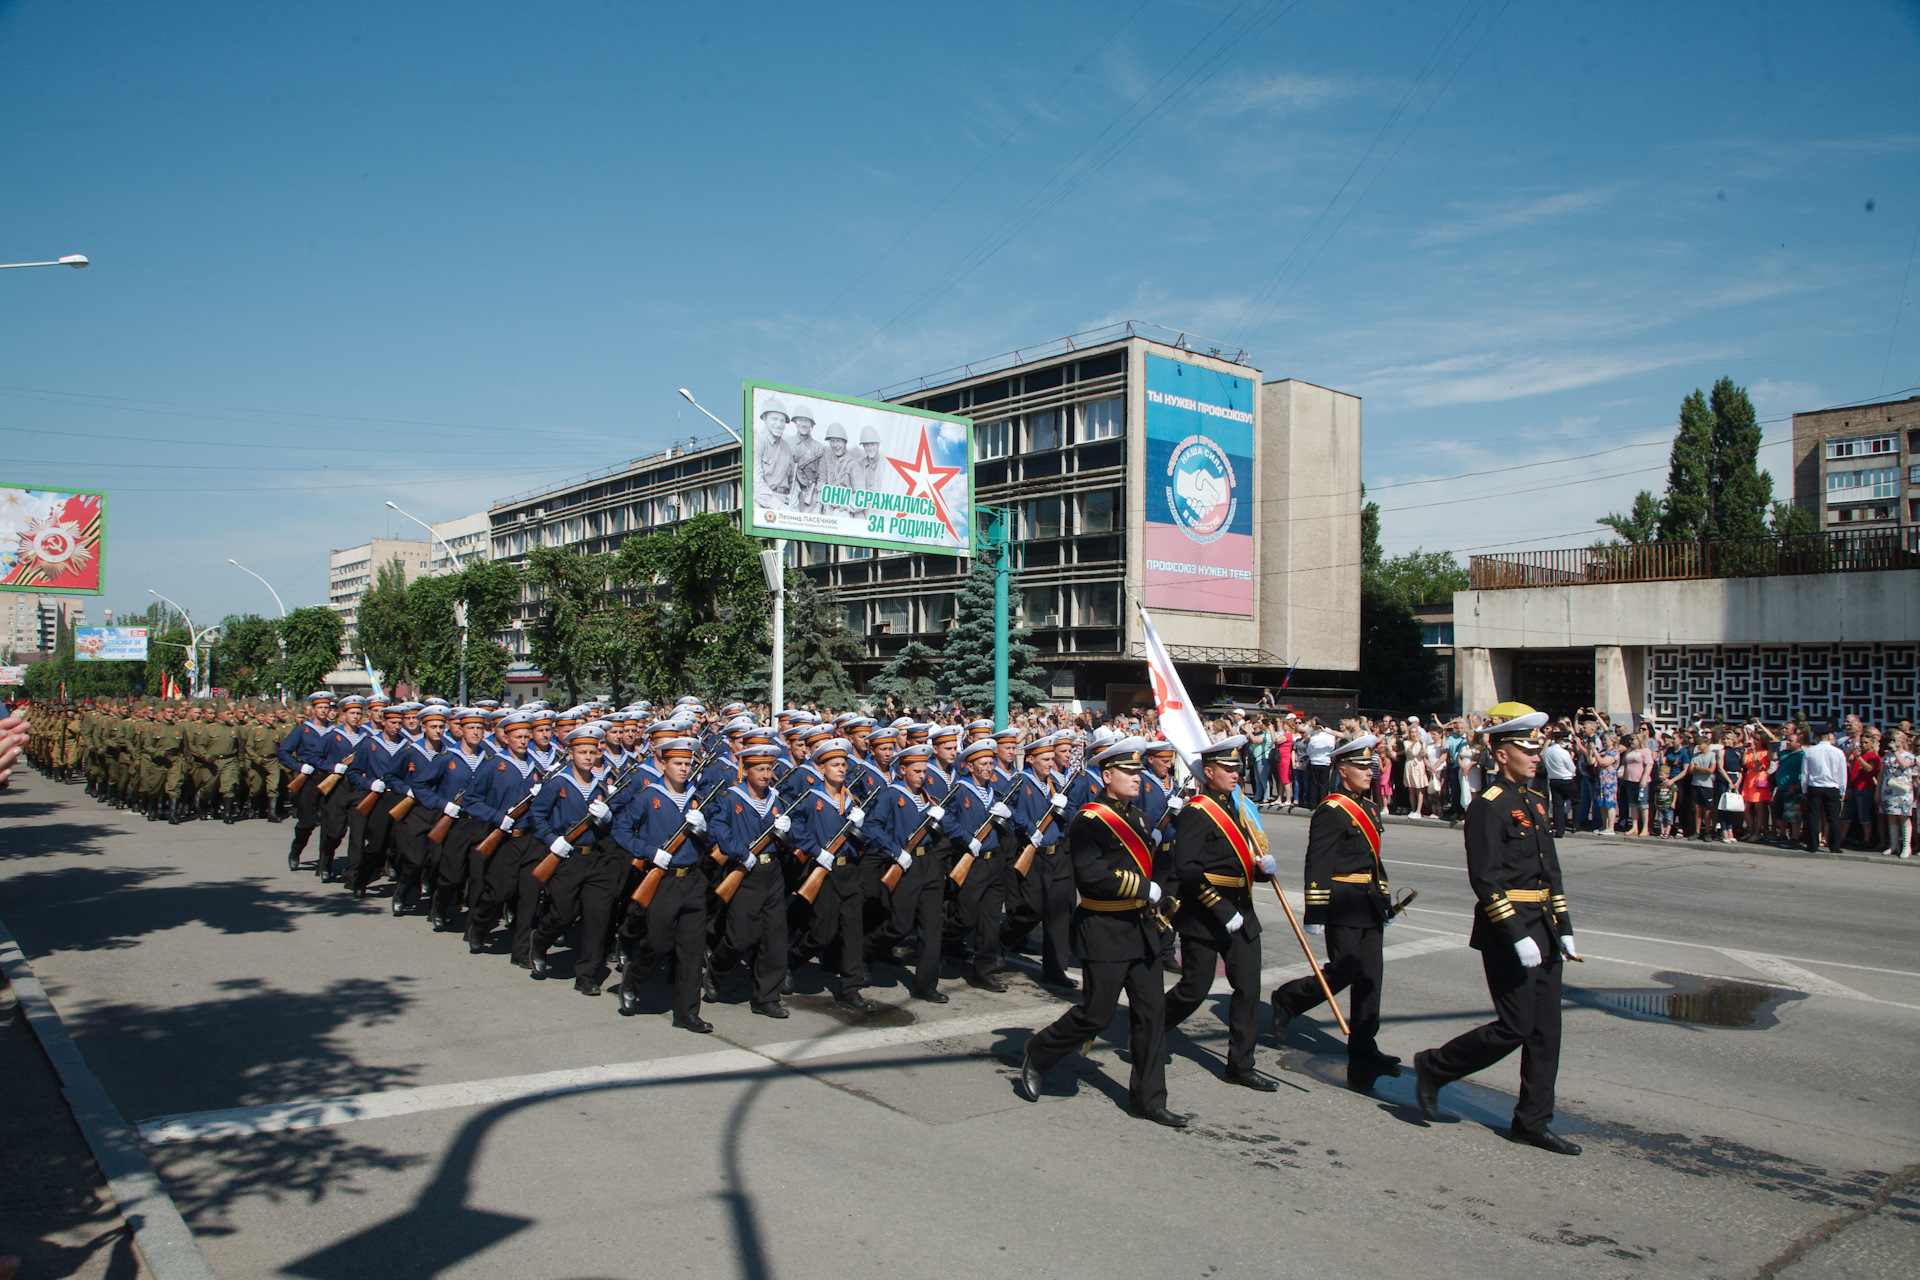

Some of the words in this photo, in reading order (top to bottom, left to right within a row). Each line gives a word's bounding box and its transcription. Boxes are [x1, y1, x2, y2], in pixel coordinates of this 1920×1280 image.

[1147, 389, 1163, 404] ТЫ
[1164, 393, 1197, 411] НУЖЕН
[1197, 401, 1253, 424] ПРОФСОЮЗУ!
[1180, 446, 1203, 465] НАША
[1204, 449, 1224, 474] СИЛА
[821, 485, 851, 506] ОНИ
[855, 489, 936, 516] СРАЖАЛИСЬ
[778, 513, 803, 522] Леонид
[803, 516, 838, 526] ПАСЕЧНИК
[867, 514, 885, 533] ЗА
[889, 517, 946, 540] РОДИНУ!
[1182, 509, 1190, 519] В
[1188, 515, 1222, 531] ЕДИНСТВЕ
[1146, 559, 1197, 575] ПРОФСОЮЗ
[1198, 564, 1228, 578] НУЖЕН
[1229, 568, 1252, 581] ТЕБЕ!
